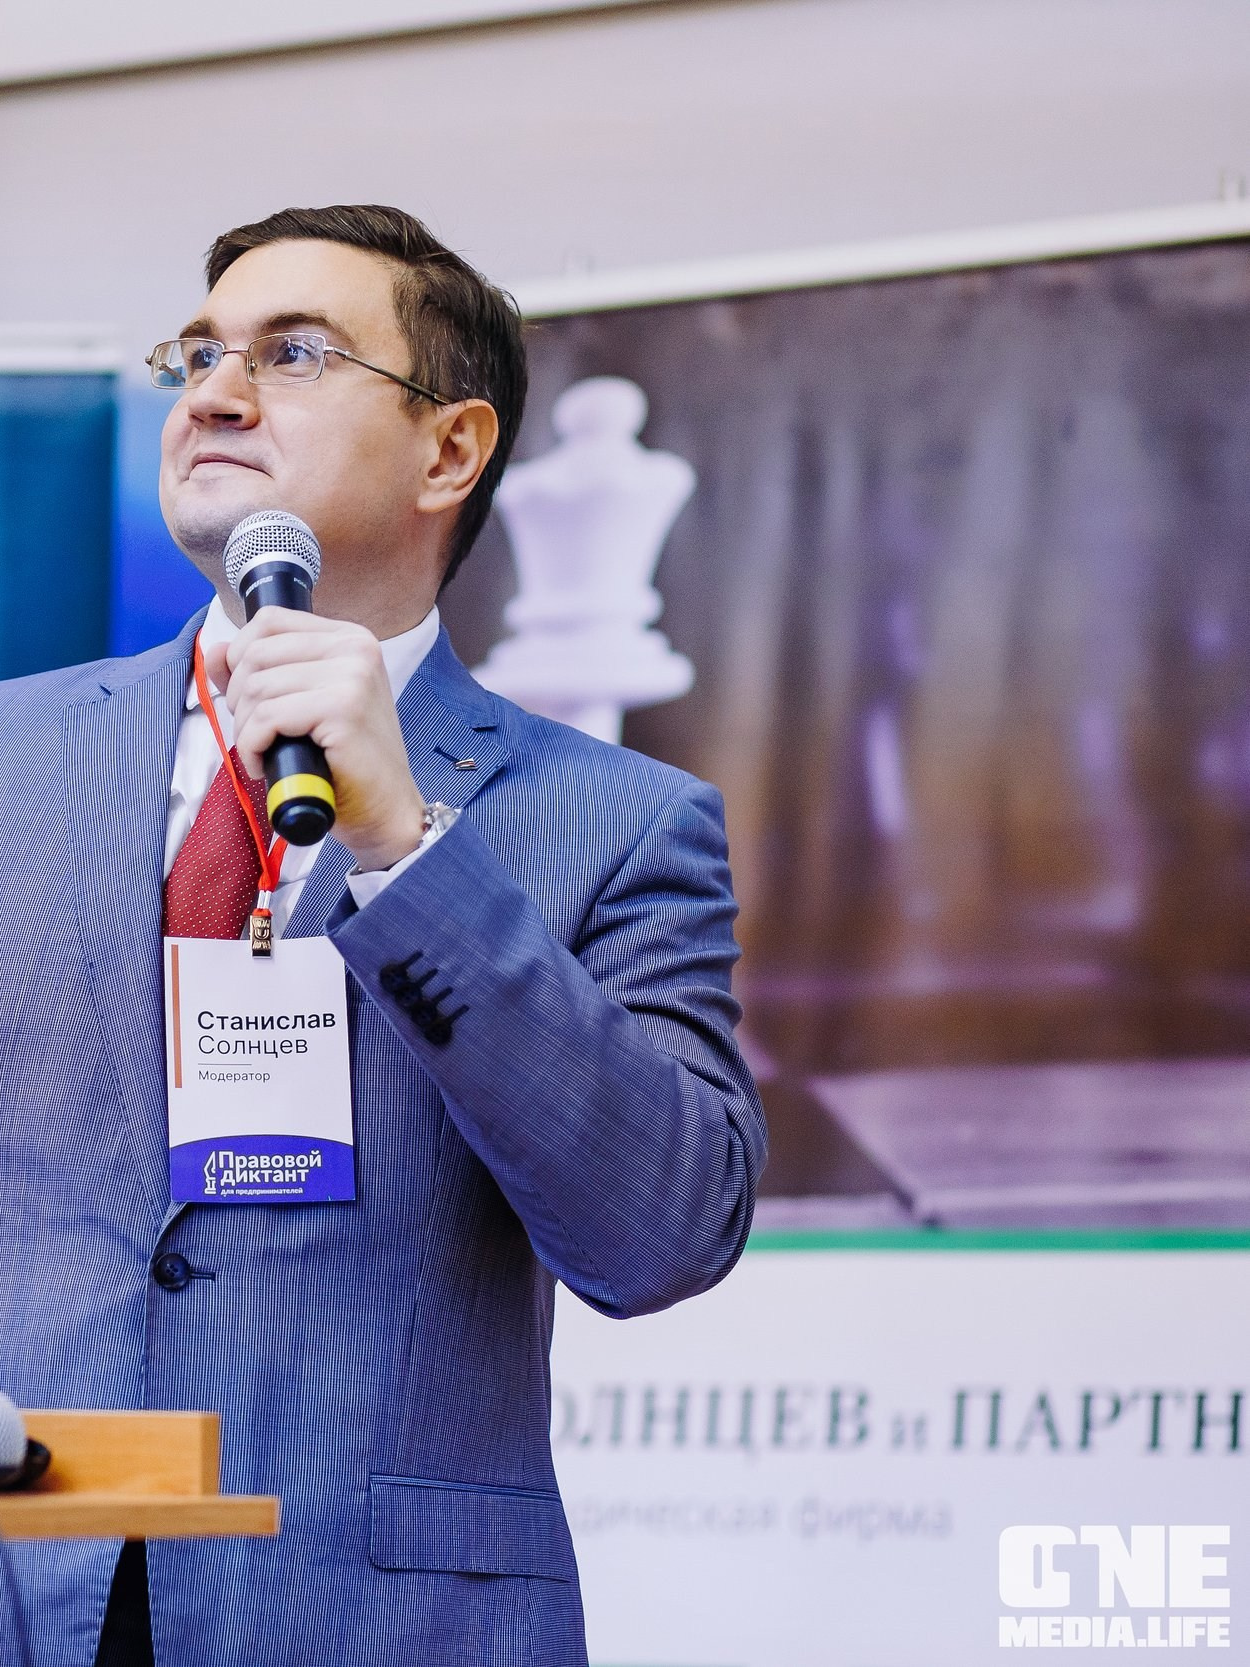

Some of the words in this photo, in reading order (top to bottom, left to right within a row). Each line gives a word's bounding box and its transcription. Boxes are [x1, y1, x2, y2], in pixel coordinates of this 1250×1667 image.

[197, 1010, 336, 1030] Станислав
[198, 1035, 309, 1058] Солнцев
[198, 1070, 271, 1083] Модератор
[218, 1150, 322, 1170] Правовой
[220, 1169, 309, 1187] диктант
[220, 1189, 235, 1197] для
[236, 1187, 304, 1196] предпринимателей
